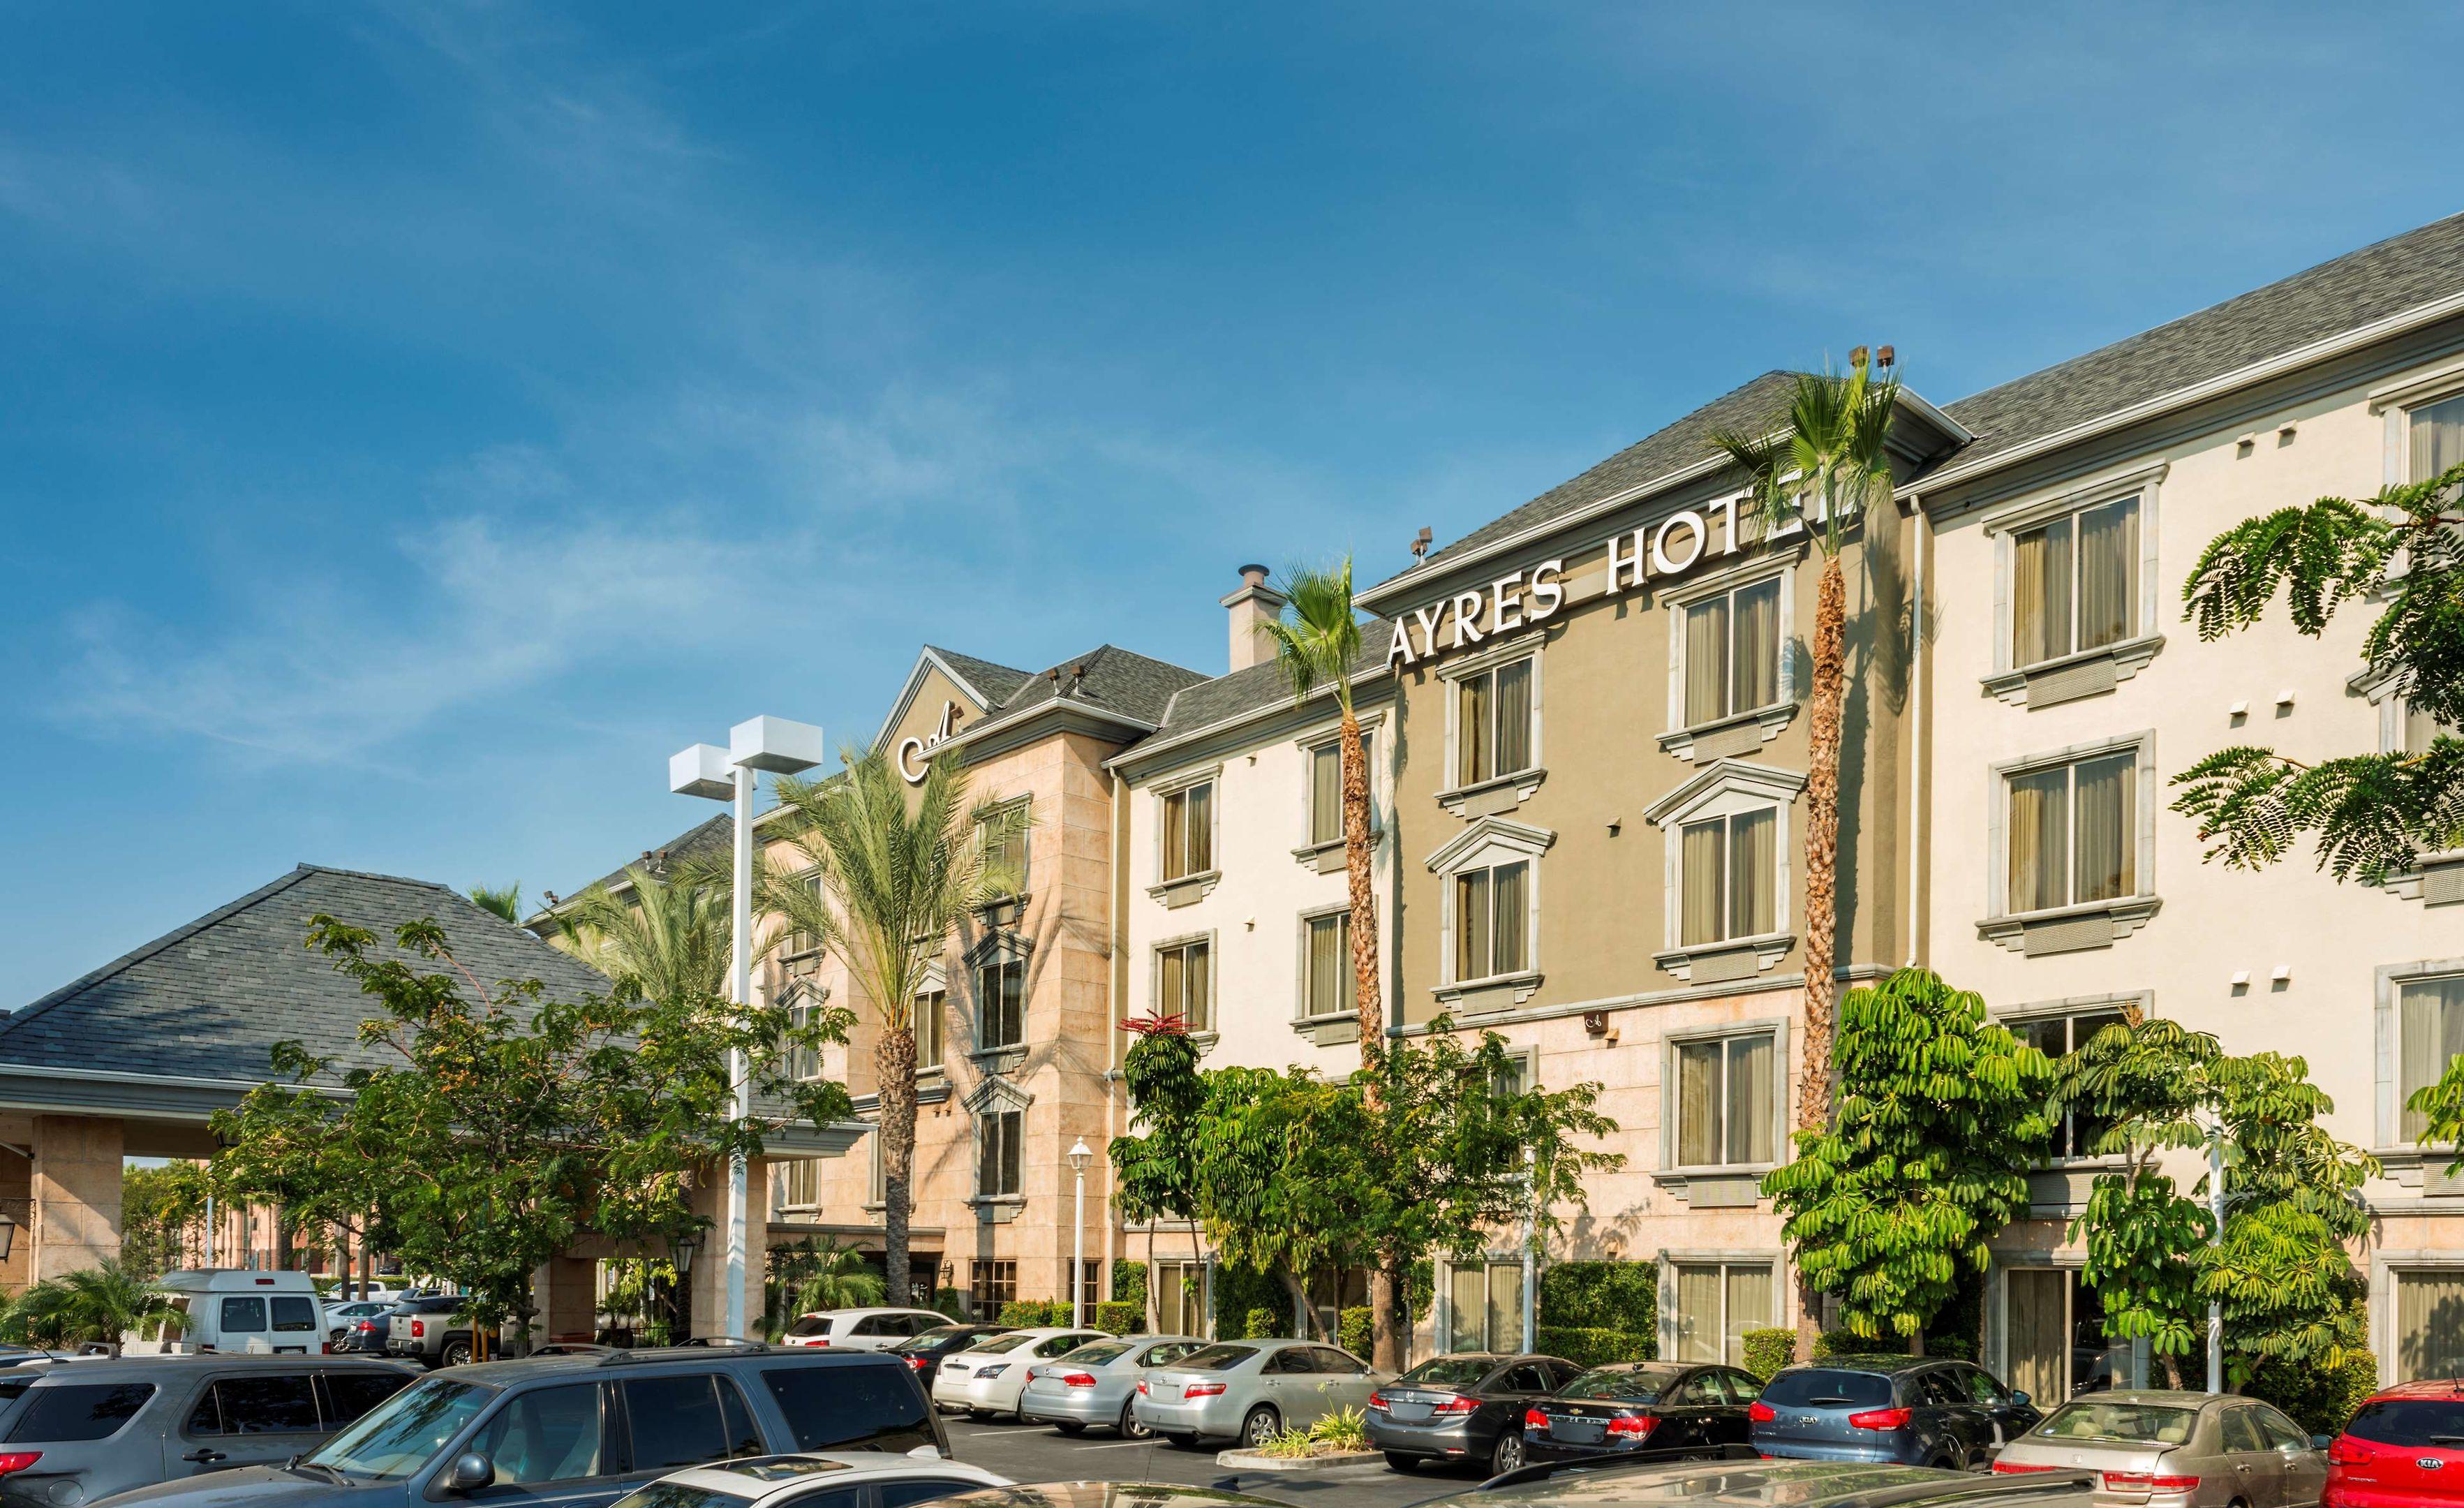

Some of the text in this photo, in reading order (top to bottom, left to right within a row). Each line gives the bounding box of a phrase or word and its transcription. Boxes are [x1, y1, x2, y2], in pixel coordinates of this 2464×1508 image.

[1386, 559, 1566, 670] AYRES
[1801, 1416, 1816, 1424] KIA
[2419, 1458, 2440, 1469] KIA
